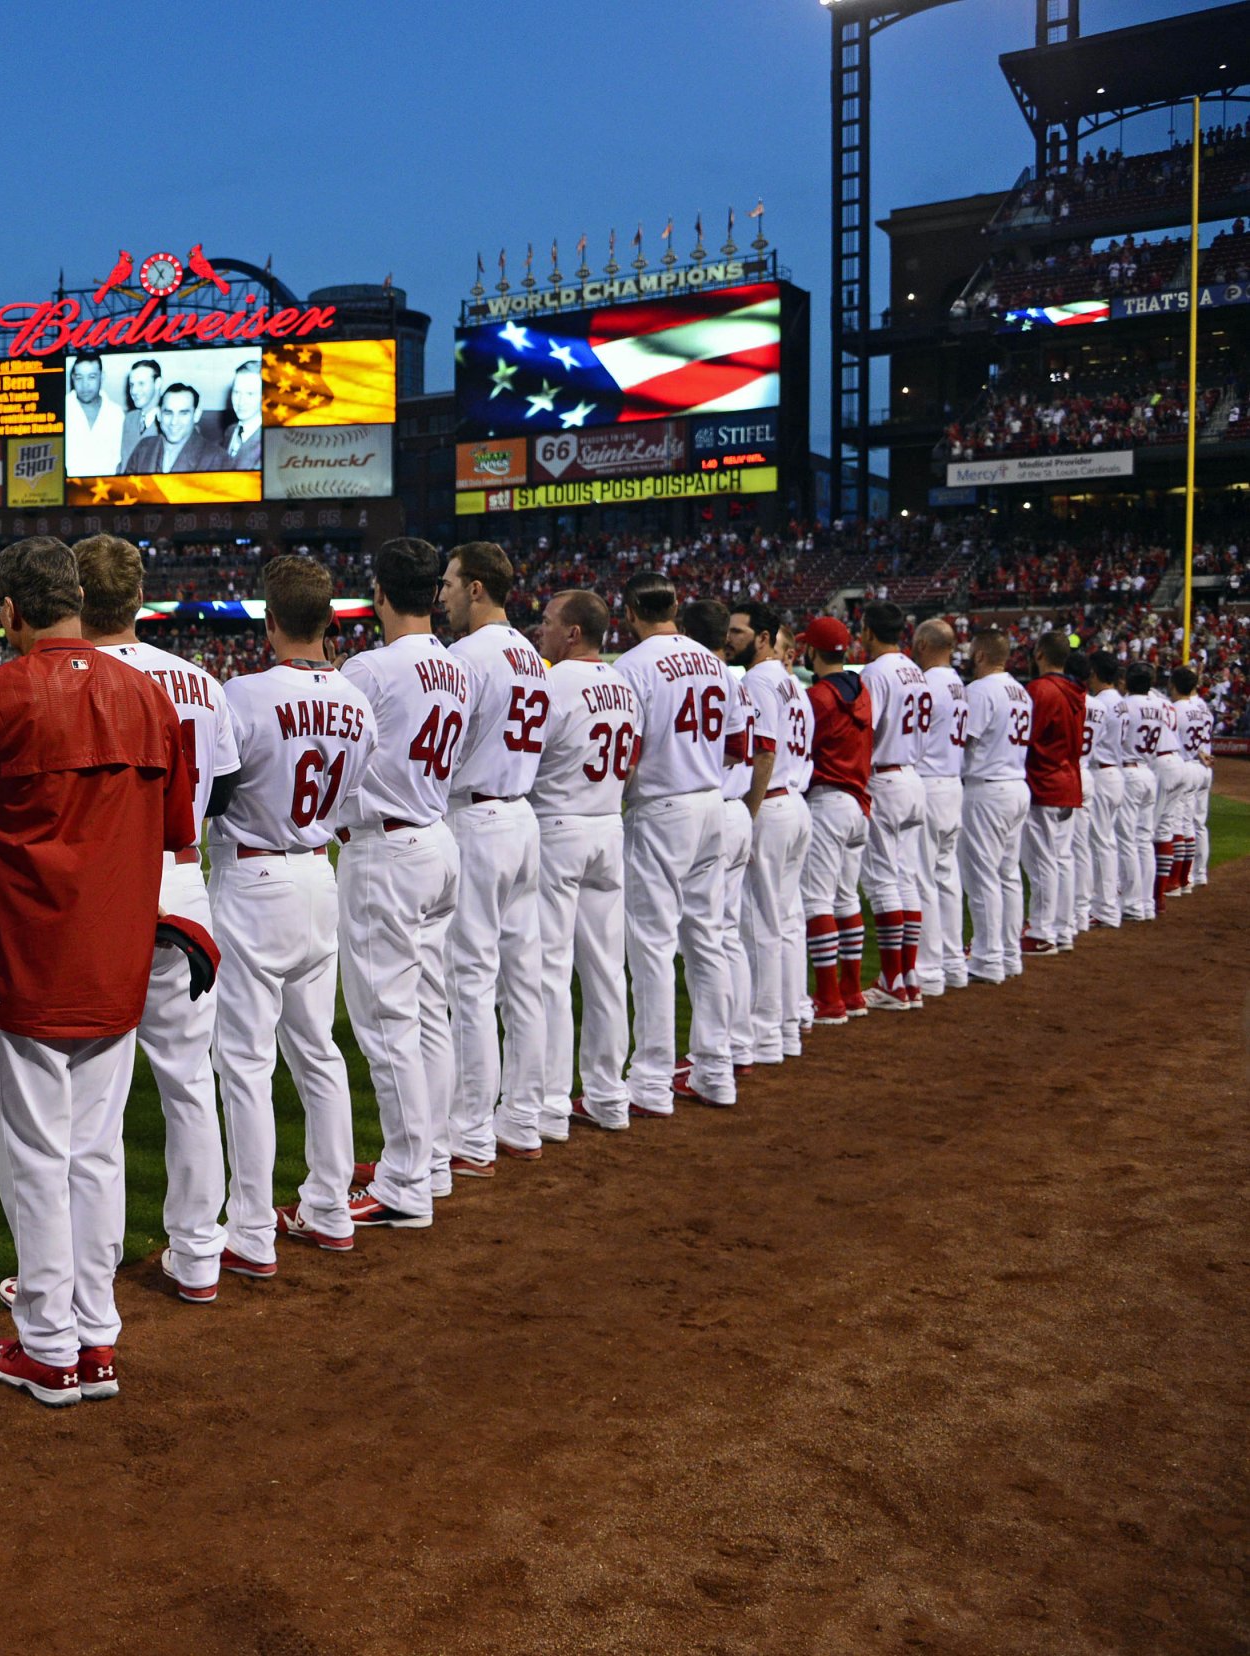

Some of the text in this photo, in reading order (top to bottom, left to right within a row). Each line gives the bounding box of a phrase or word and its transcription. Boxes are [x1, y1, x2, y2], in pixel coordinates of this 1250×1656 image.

[487, 262, 745, 317] WORLD CHAMPIONS
[1123, 291, 1189, 315] THAT'S
[1199, 288, 1213, 305] A
[542, 440, 571, 462] 66
[717, 424, 776, 447] STIFEL
[14, 457, 57, 478] SHOT
[19, 443, 54, 461] HOT
[279, 452, 376, 470] Schnucks
[577, 441, 623, 465] Saint
[1017, 456, 1092, 469] Medical Provider
[956, 468, 999, 482] Mercy
[1080, 464, 1121, 476] Cardinals
[518, 487, 543, 508] ST.
[545, 482, 593, 506] LOUIS
[600, 469, 741, 500] POST-DISPATCH
[502, 648, 547, 681] WACHA
[655, 652, 723, 682] SIEGRIST
[145, 670, 215, 712] THAL
[414, 658, 467, 705] HARRIS
[582, 684, 634, 714] CHOATE
[674, 685, 726, 743] 46
[902, 691, 933, 735] 28
[275, 700, 364, 743] MANESS
[503, 685, 550, 754] 52
[1008, 708, 1031, 747] 32
[408, 704, 463, 781] 40
[582, 722, 633, 782] 36
[1135, 725, 1161, 754] 38
[290, 749, 346, 828] 61
